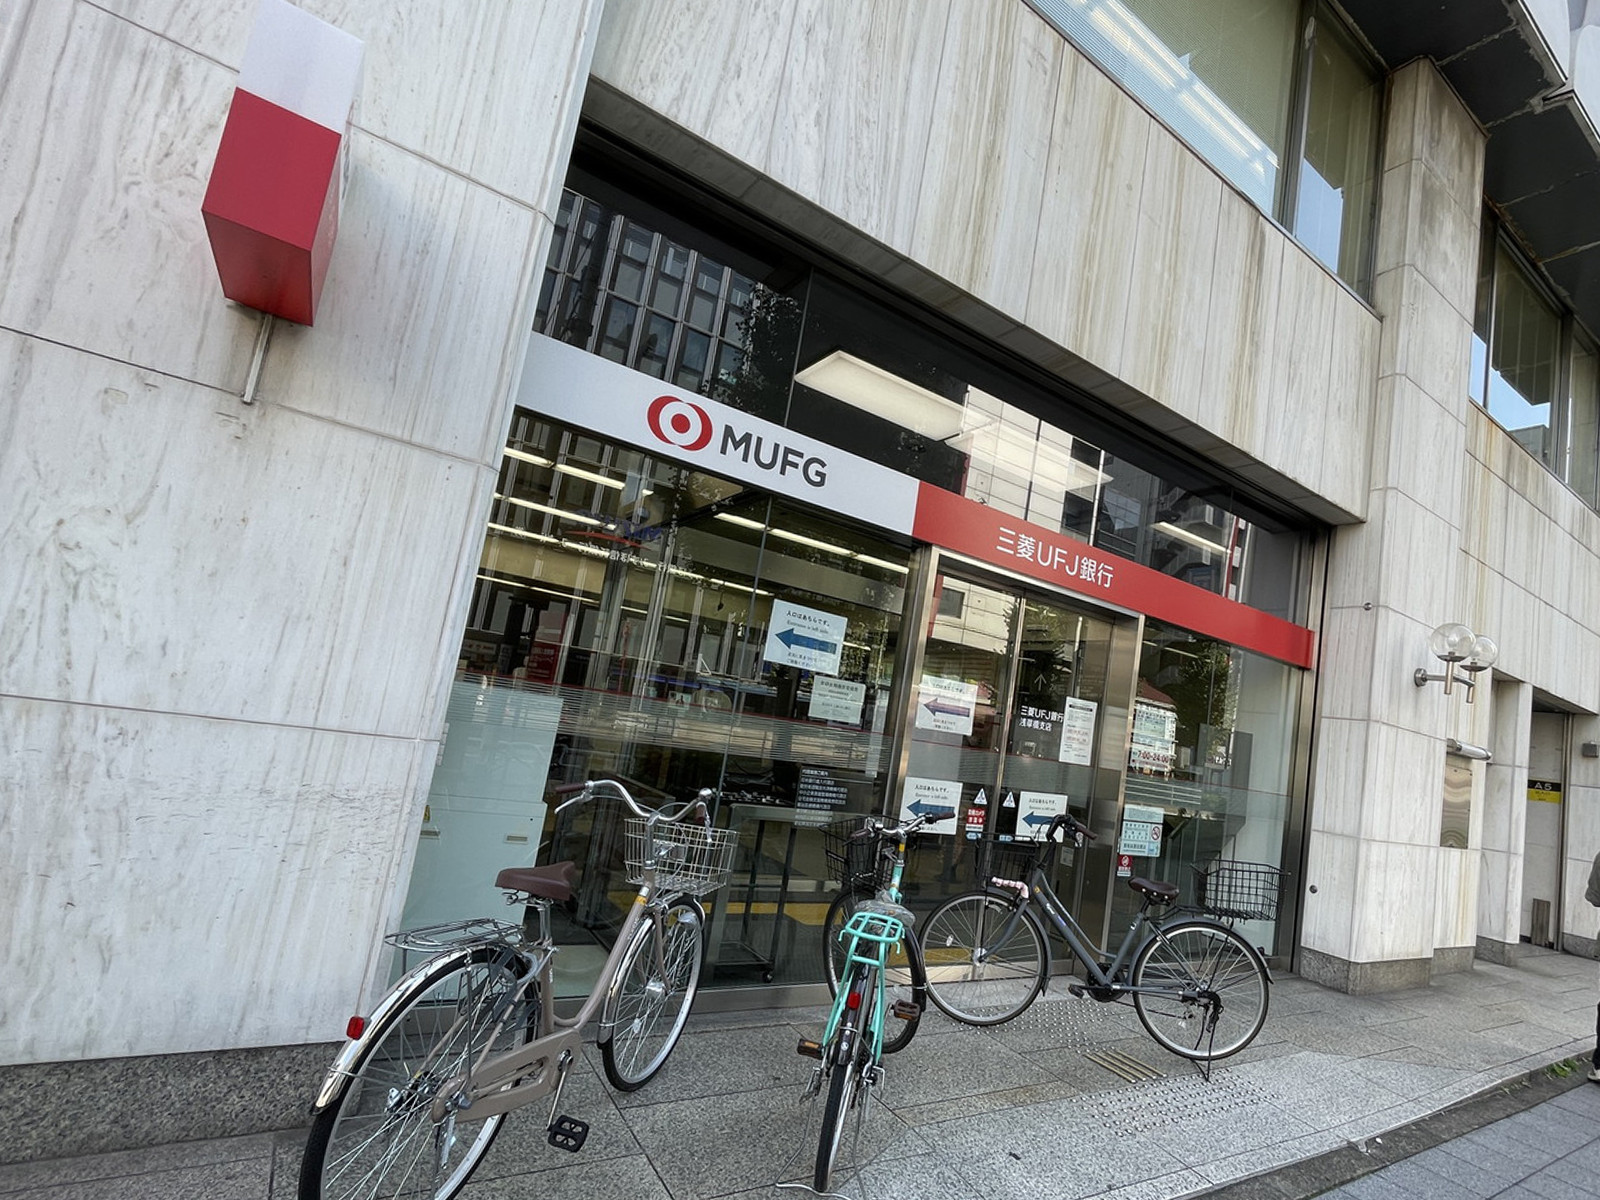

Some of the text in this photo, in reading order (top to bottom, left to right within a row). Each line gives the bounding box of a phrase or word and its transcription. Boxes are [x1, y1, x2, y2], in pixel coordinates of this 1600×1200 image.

[719, 424, 827, 487] MUFG
[996, 526, 1114, 588] 三菱UFJ銀行
